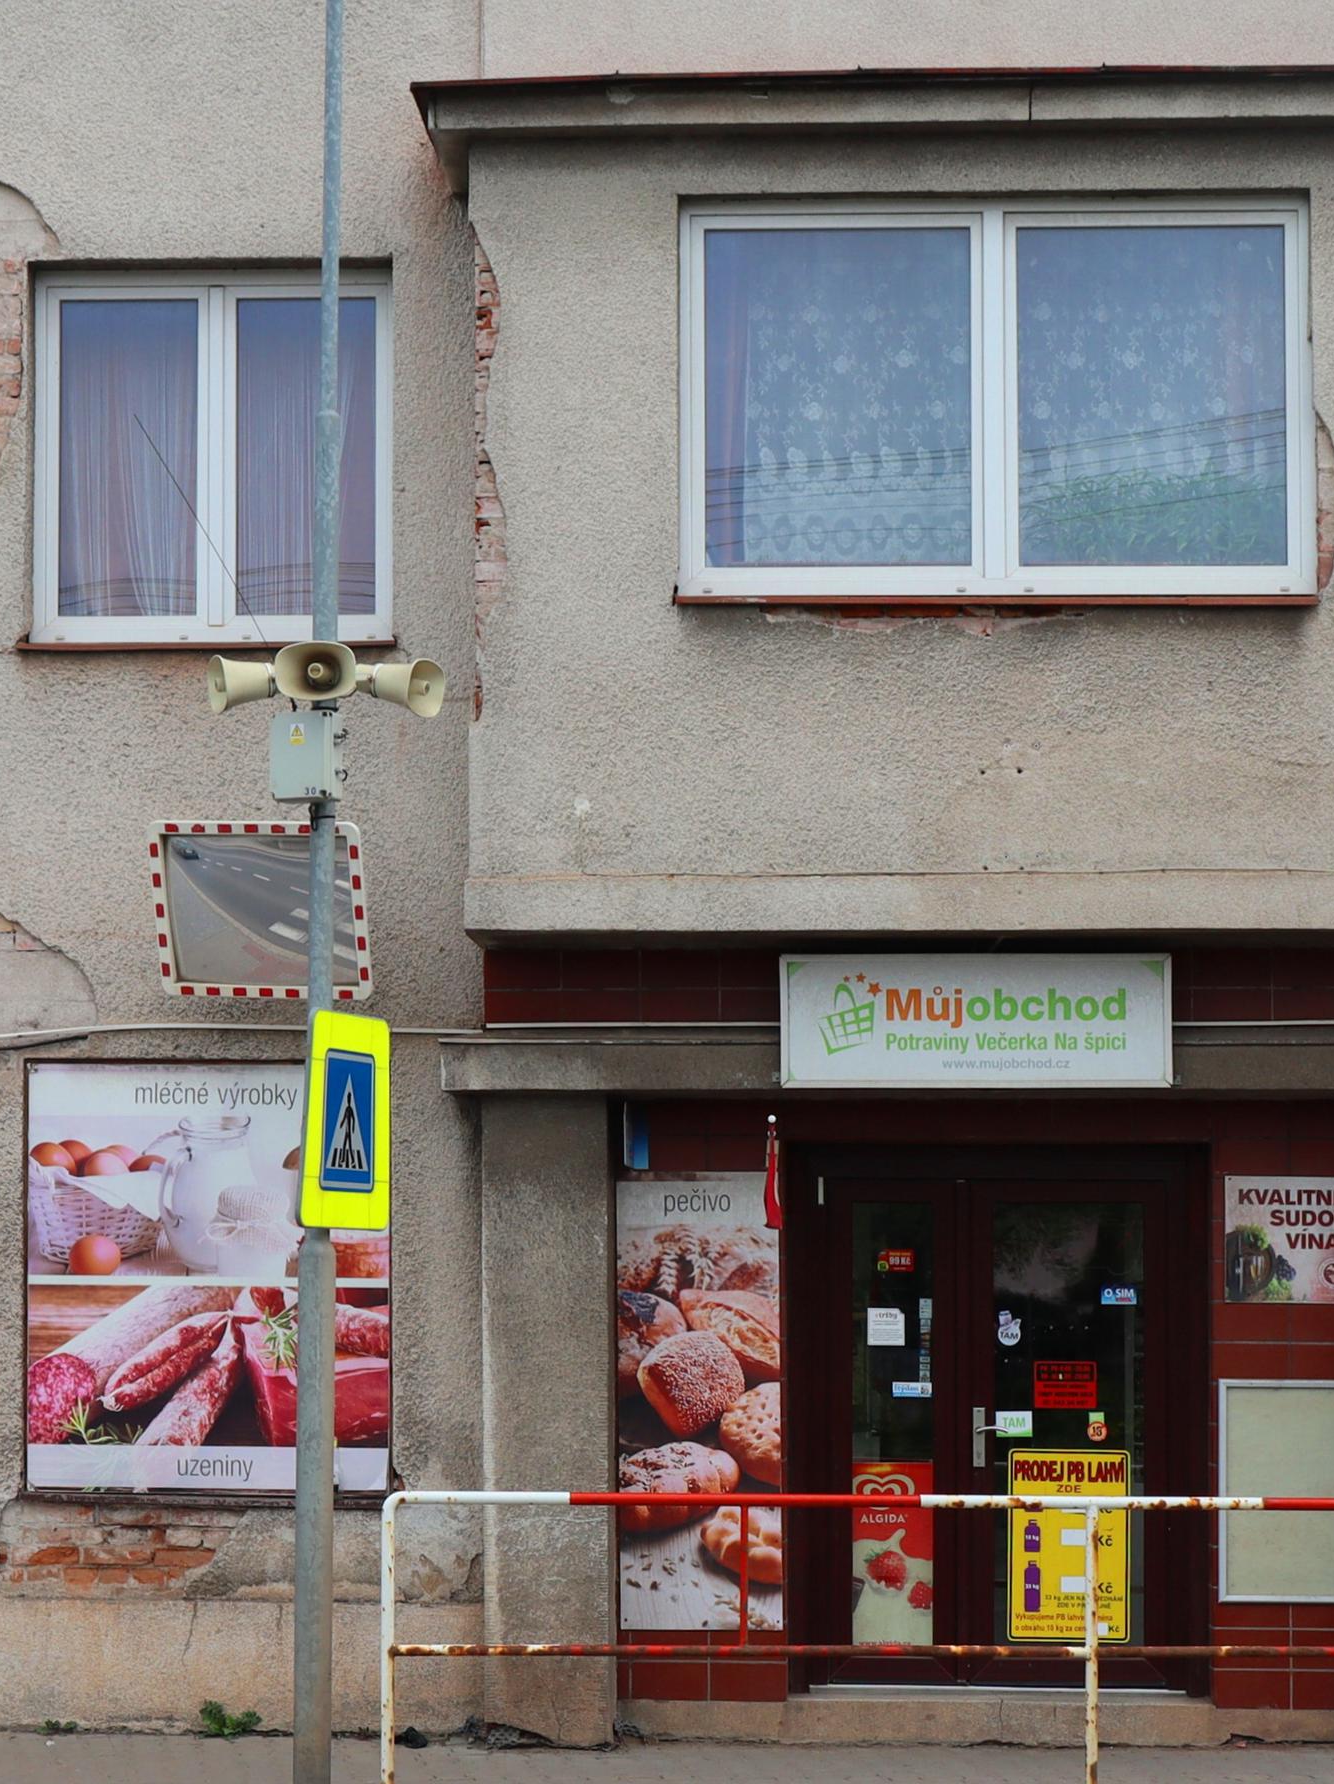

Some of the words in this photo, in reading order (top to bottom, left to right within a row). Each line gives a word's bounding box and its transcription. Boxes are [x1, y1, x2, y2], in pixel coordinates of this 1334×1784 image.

[884, 986, 1127, 1029] Můjobchod
[885, 1032, 968, 1055] Potraviny
[976, 1032, 1048, 1051] Večerka
[1054, 1033, 1078, 1051] Na
[1084, 1032, 1127, 1054] špici
[941, 1057, 1071, 1072] www.mujobchod.cz
[134, 1082, 209, 1105] mléčné
[217, 1083, 298, 1110] výrobky
[664, 1188, 731, 1216] pečivo
[1115, 1288, 1134, 1298] SIM
[1002, 1417, 1026, 1428] TAM
[177, 1454, 253, 1482] uzeniny
[1013, 1459, 1065, 1482] PRODEJ
[1067, 1460, 1085, 1483] PB
[1087, 1457, 1125, 1483] LAHVÍ
[1056, 1484, 1082, 1493] ZDE
[860, 1514, 906, 1523] ALGIDA
